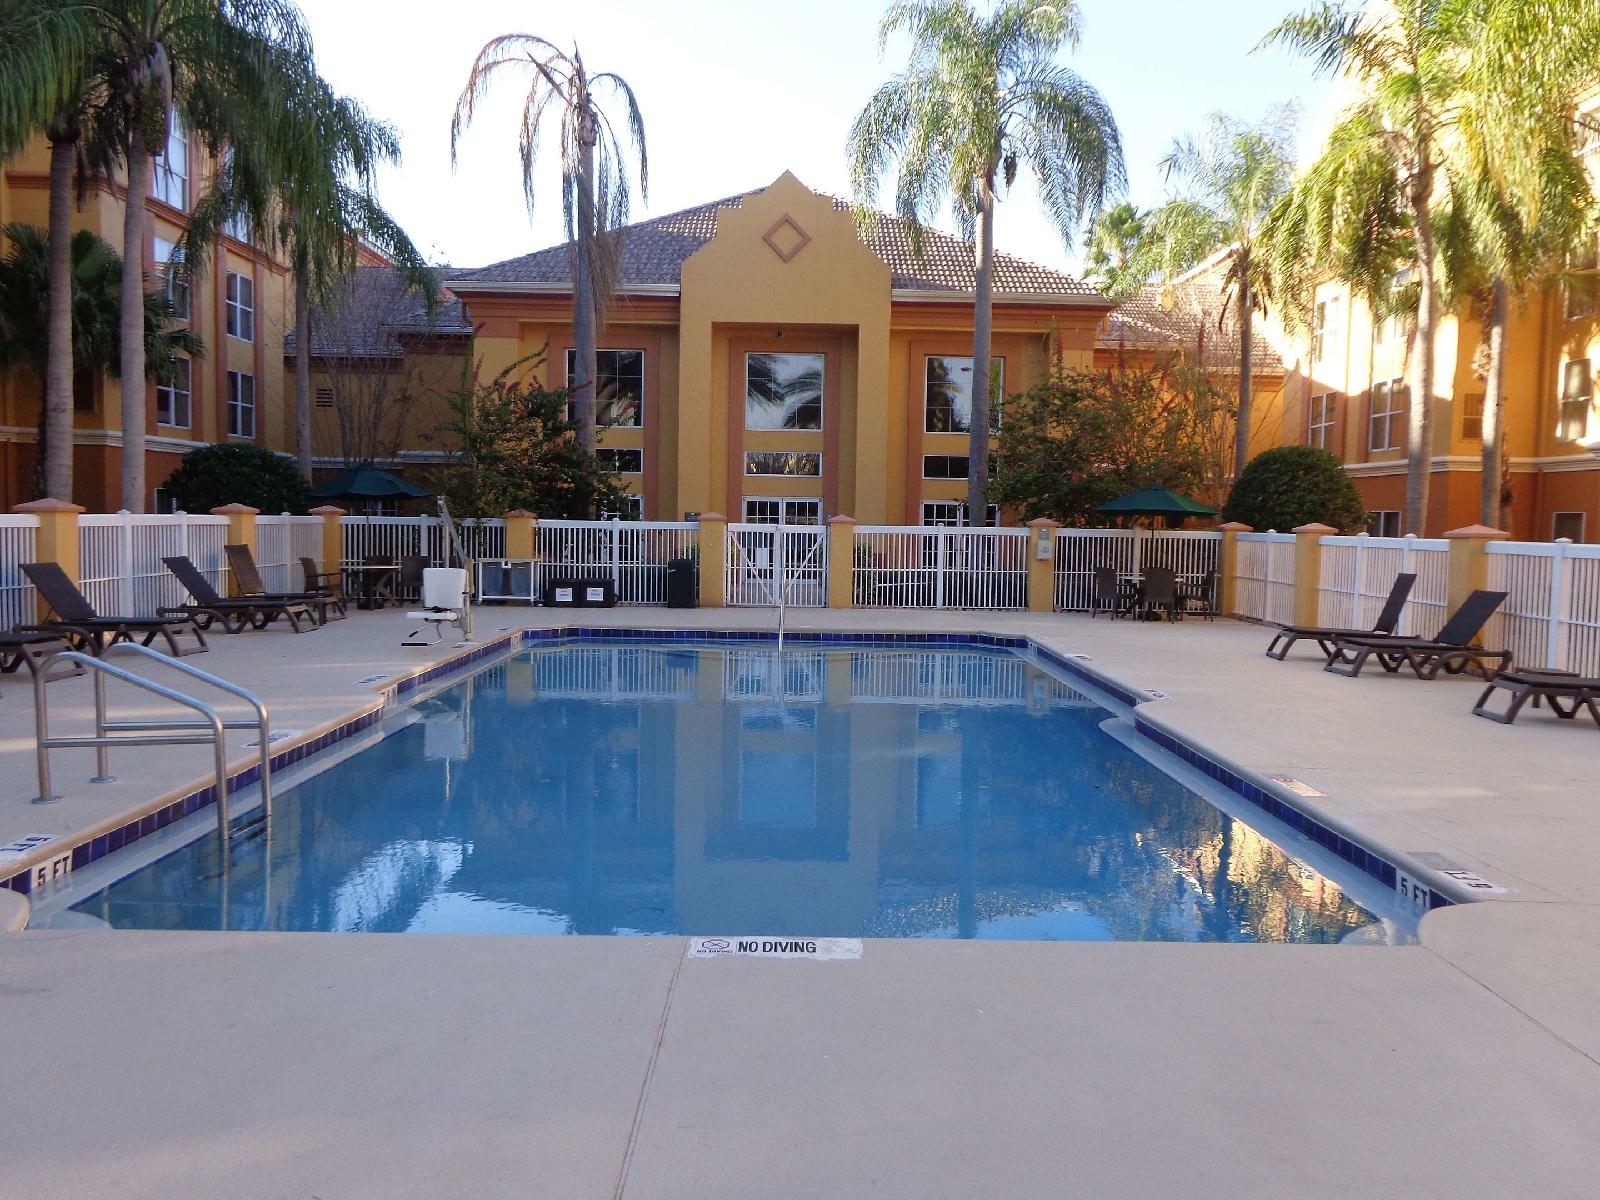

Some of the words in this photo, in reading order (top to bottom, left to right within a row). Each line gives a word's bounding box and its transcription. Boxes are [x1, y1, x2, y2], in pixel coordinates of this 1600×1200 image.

[37, 866, 47, 887] 5
[52, 854, 71, 880] FT
[1400, 876, 1409, 897] 5
[1412, 883, 1428, 908] FT
[737, 940, 759, 954] NO
[762, 940, 817, 954] DIVING
